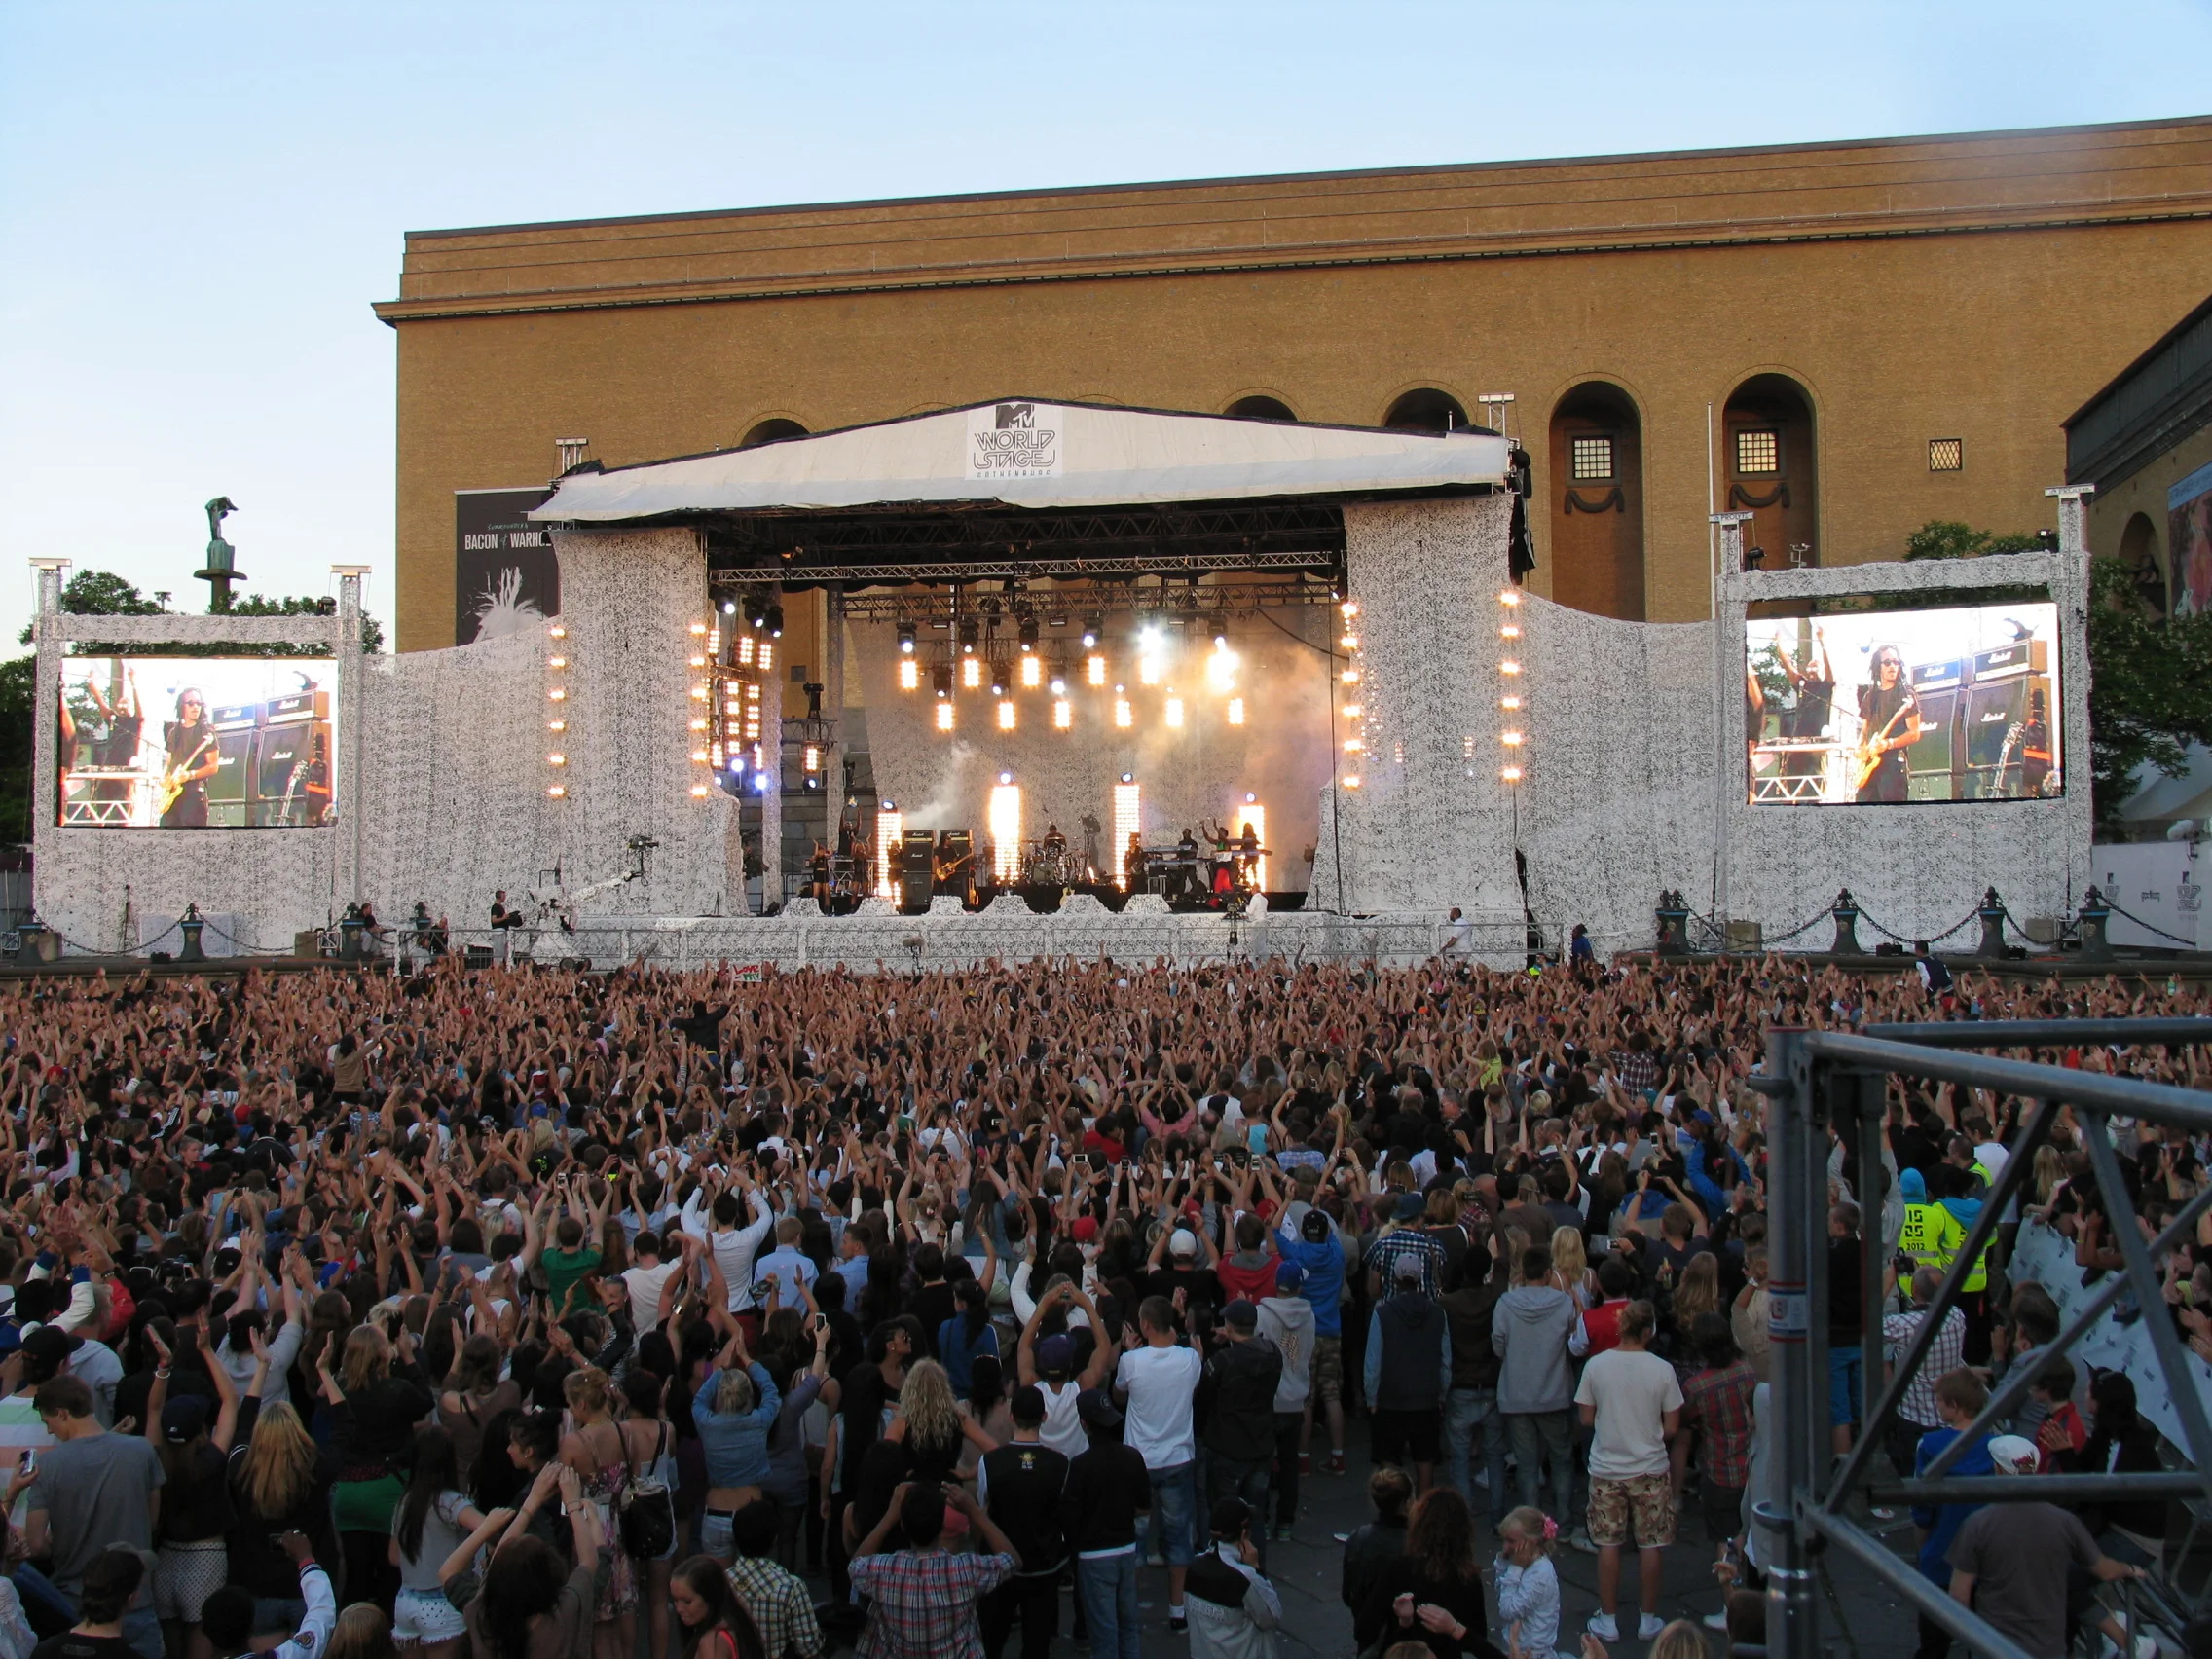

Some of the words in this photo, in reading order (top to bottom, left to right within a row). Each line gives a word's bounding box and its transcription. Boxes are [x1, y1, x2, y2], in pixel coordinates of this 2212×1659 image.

[995, 403, 1034, 429] MTV
[974, 430, 1056, 451] WORLD
[974, 449, 1056, 469] STAGE
[977, 469, 1051, 478] GOTHENBURG
[464, 533, 498, 550] BACON
[510, 531, 552, 548] WARHO
[1908, 1209, 1923, 1223] 15
[1905, 1225, 1924, 1237] 25
[1906, 1242, 1925, 1251] 2012
